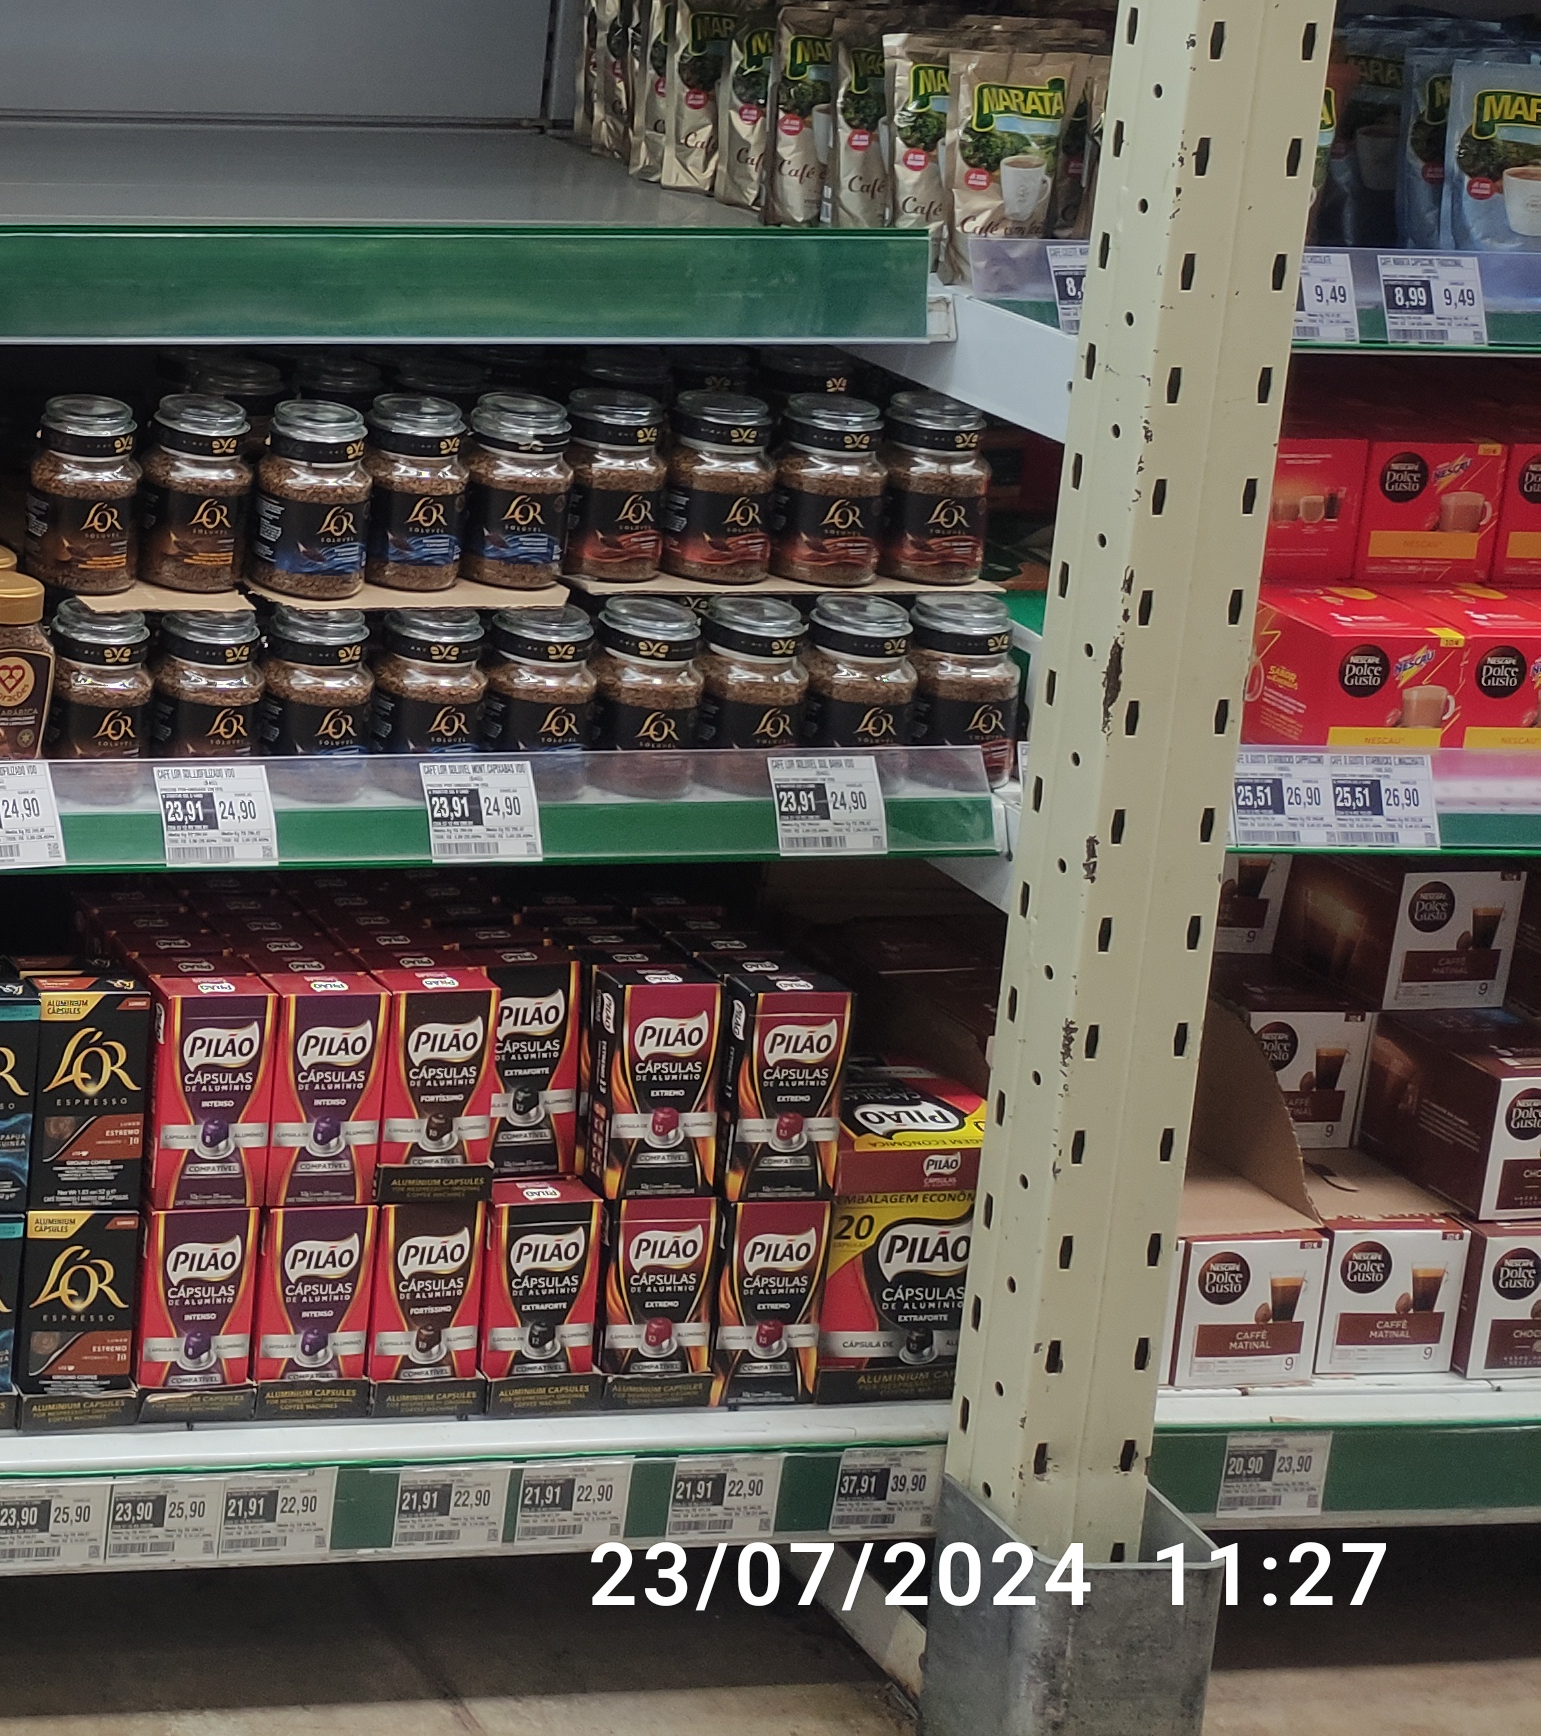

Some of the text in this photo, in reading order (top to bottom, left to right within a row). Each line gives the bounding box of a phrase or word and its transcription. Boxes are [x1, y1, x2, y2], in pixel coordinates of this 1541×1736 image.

[1442, 285, 1476, 308] 9,49
[1344, 674, 1381, 686] Gusto
[1345, 665, 1382, 677] Dolce
[778, 790, 867, 812] 23,91 24,90
[1336, 785, 1419, 808] 25,51 26,90
[188, 1033, 255, 1061] PILÃO
[184, 1070, 253, 1086] CÁPSULAS
[833, 1214, 874, 1240] 20
[1369, 1329, 1411, 1339] MATINAL
[840, 1474, 926, 1495] 37,91 39,90
[227, 1496, 317, 1519] 21,91 22,90
